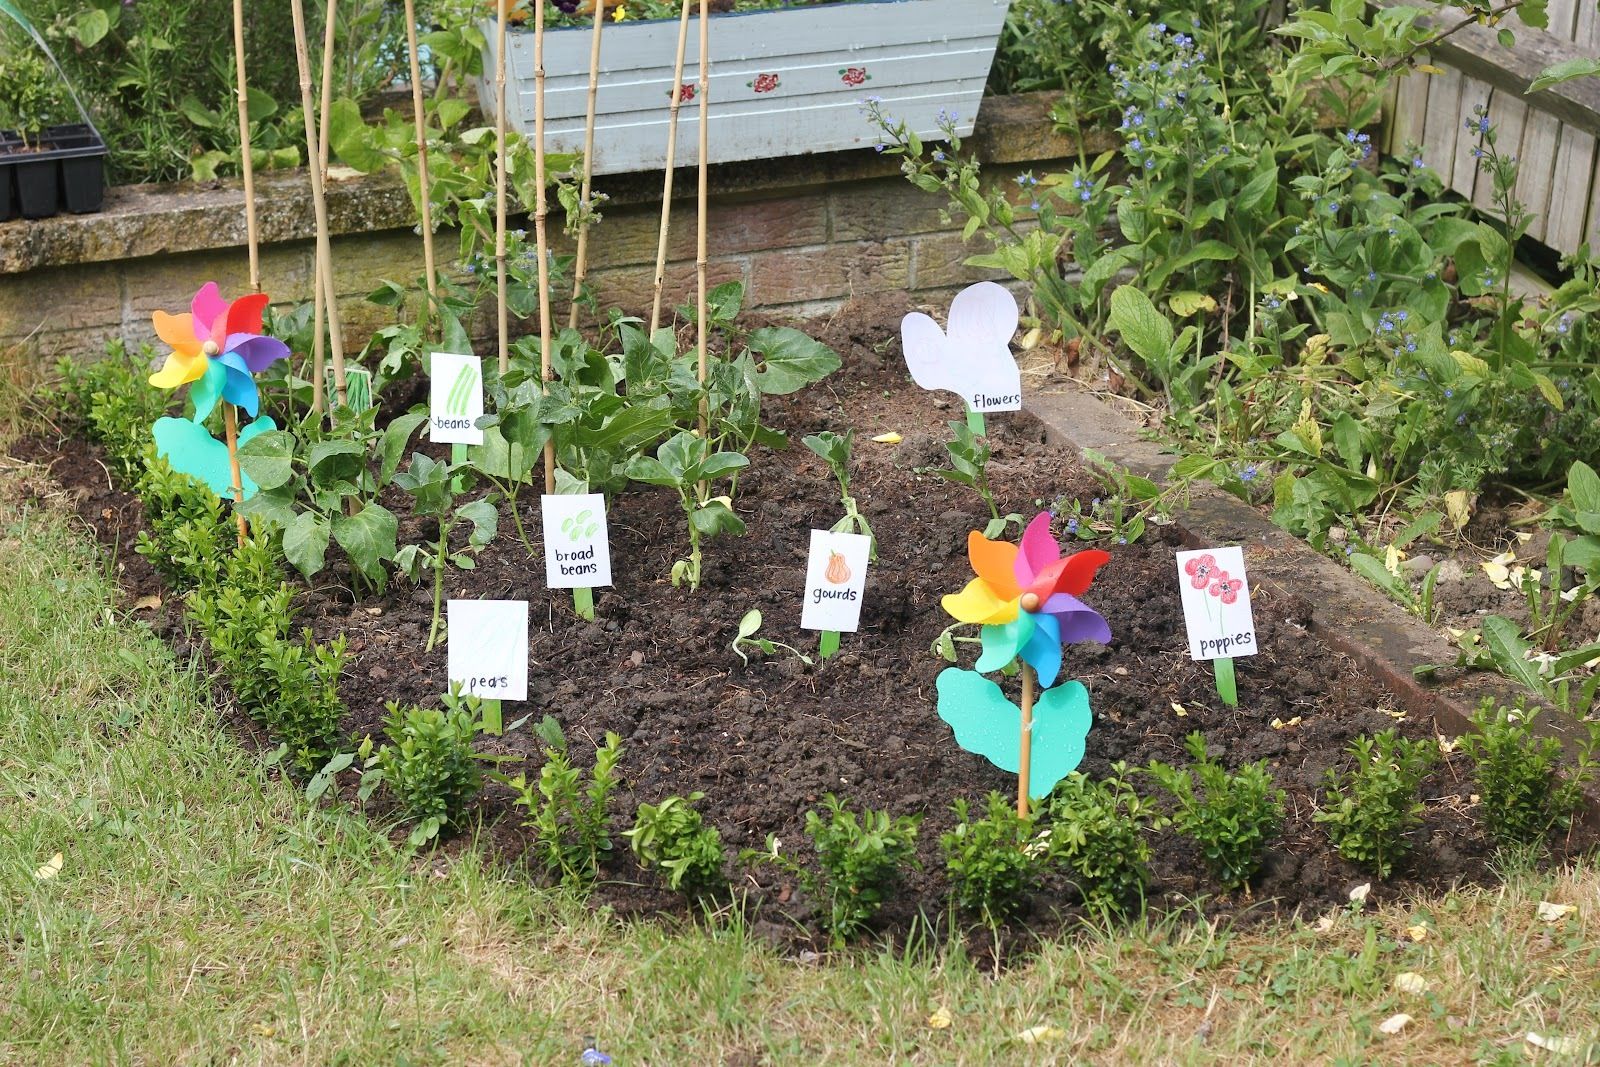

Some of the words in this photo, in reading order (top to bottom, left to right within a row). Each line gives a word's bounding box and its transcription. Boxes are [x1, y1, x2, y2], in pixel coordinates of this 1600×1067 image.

[973, 393, 1021, 408] flowers
[437, 416, 471, 429] beans
[555, 544, 594, 562] broad
[560, 563, 597, 576] beans
[813, 587, 857, 604] gourds
[1199, 631, 1252, 657] poppies
